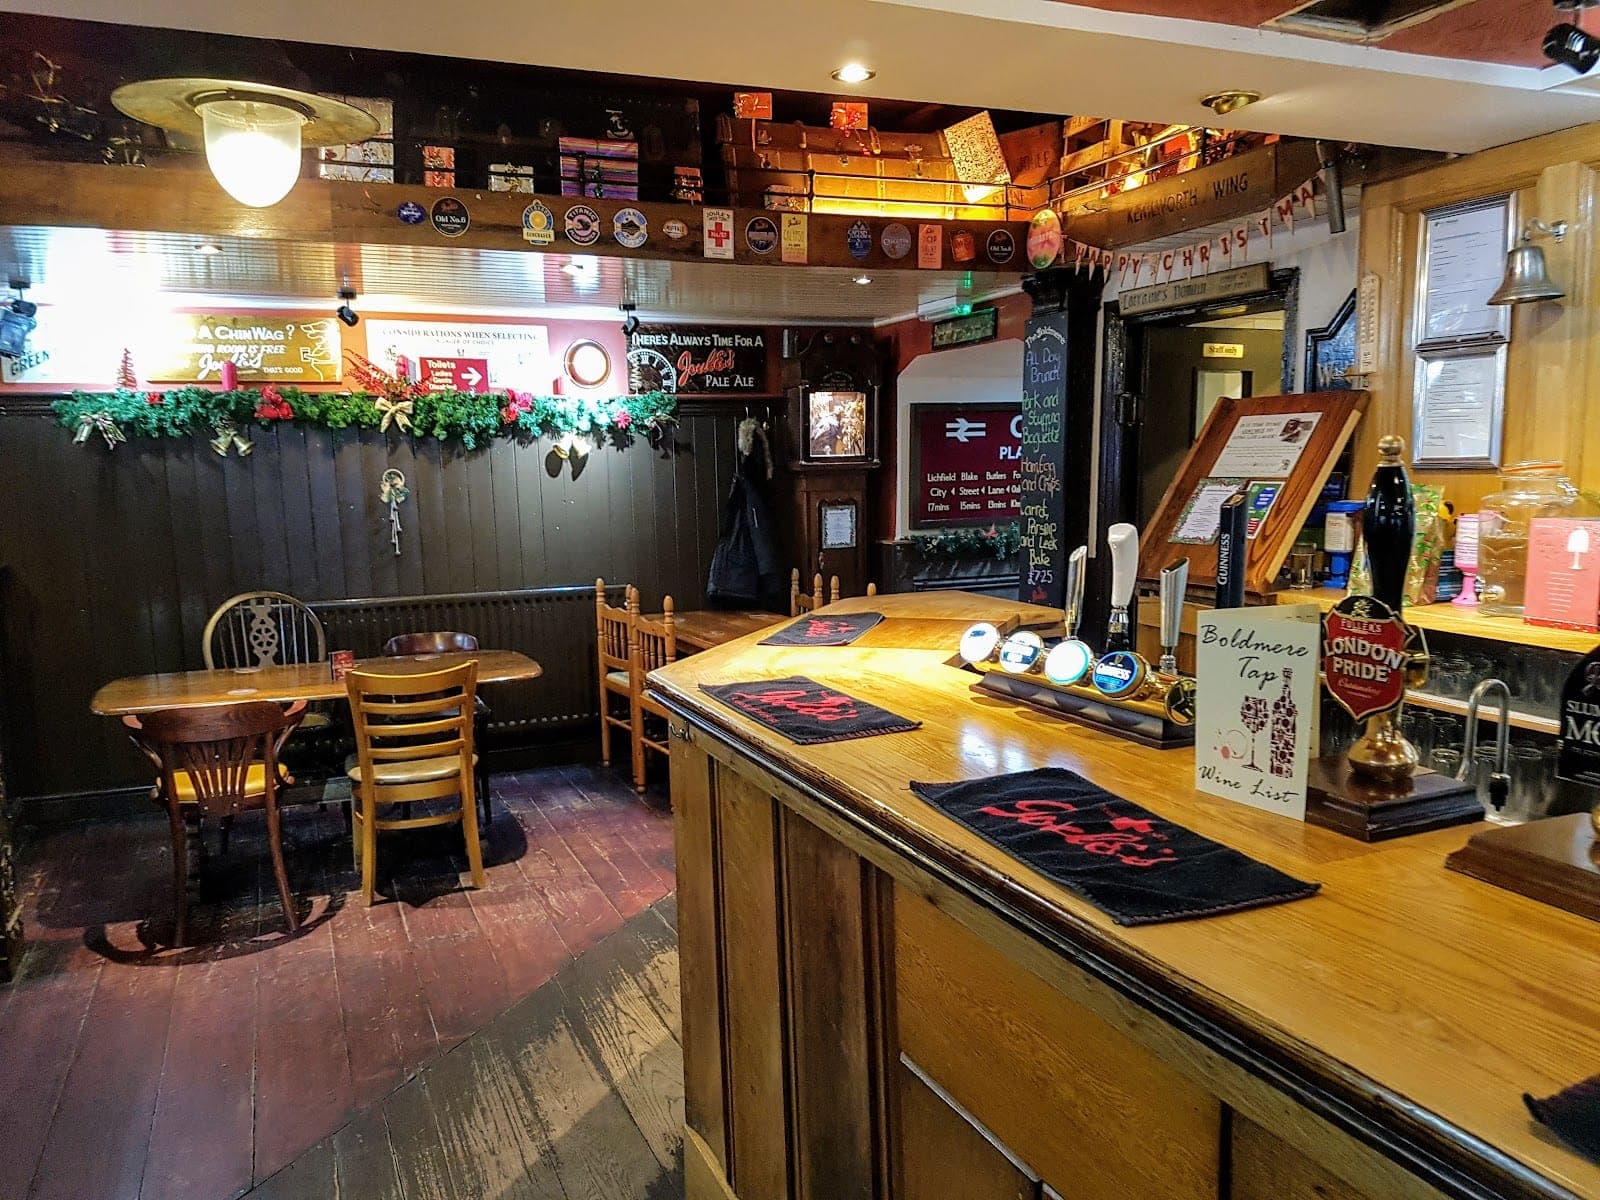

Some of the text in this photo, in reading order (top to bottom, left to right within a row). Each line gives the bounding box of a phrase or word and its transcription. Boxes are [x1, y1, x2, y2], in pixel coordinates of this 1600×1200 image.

[1213, 172, 1249, 199] WING
[435, 214, 448, 223] Old
[568, 207, 598, 222] TITANIC
[1076, 186, 1314, 274] HAPPY CHRISTMA
[464, 331, 490, 339] WHEN
[670, 333, 711, 346] ALWAYS
[712, 334, 733, 347] TIME
[735, 335, 753, 347] FOR
[755, 336, 763, 347] A
[1208, 346, 1225, 354] Staff
[426, 359, 457, 369] Toilets
[705, 375, 754, 387] PALE ALE
[927, 470, 1021, 482] Lichfield Blake Butlers Fo
[930, 487, 947, 499] City
[959, 486, 980, 496] Street
[988, 485, 1005, 495] Lane
[927, 502, 950, 512] 17mins
[960, 501, 981, 511] 15mins
[1217, 532, 1231, 586] GUINNESS
[1201, 624, 1309, 657] Boldmere
[1324, 636, 1403, 670] LONDON
[1238, 656, 1279, 691] Tap
[1333, 656, 1390, 682] PRIDE
[1198, 766, 1300, 803] Wine List
